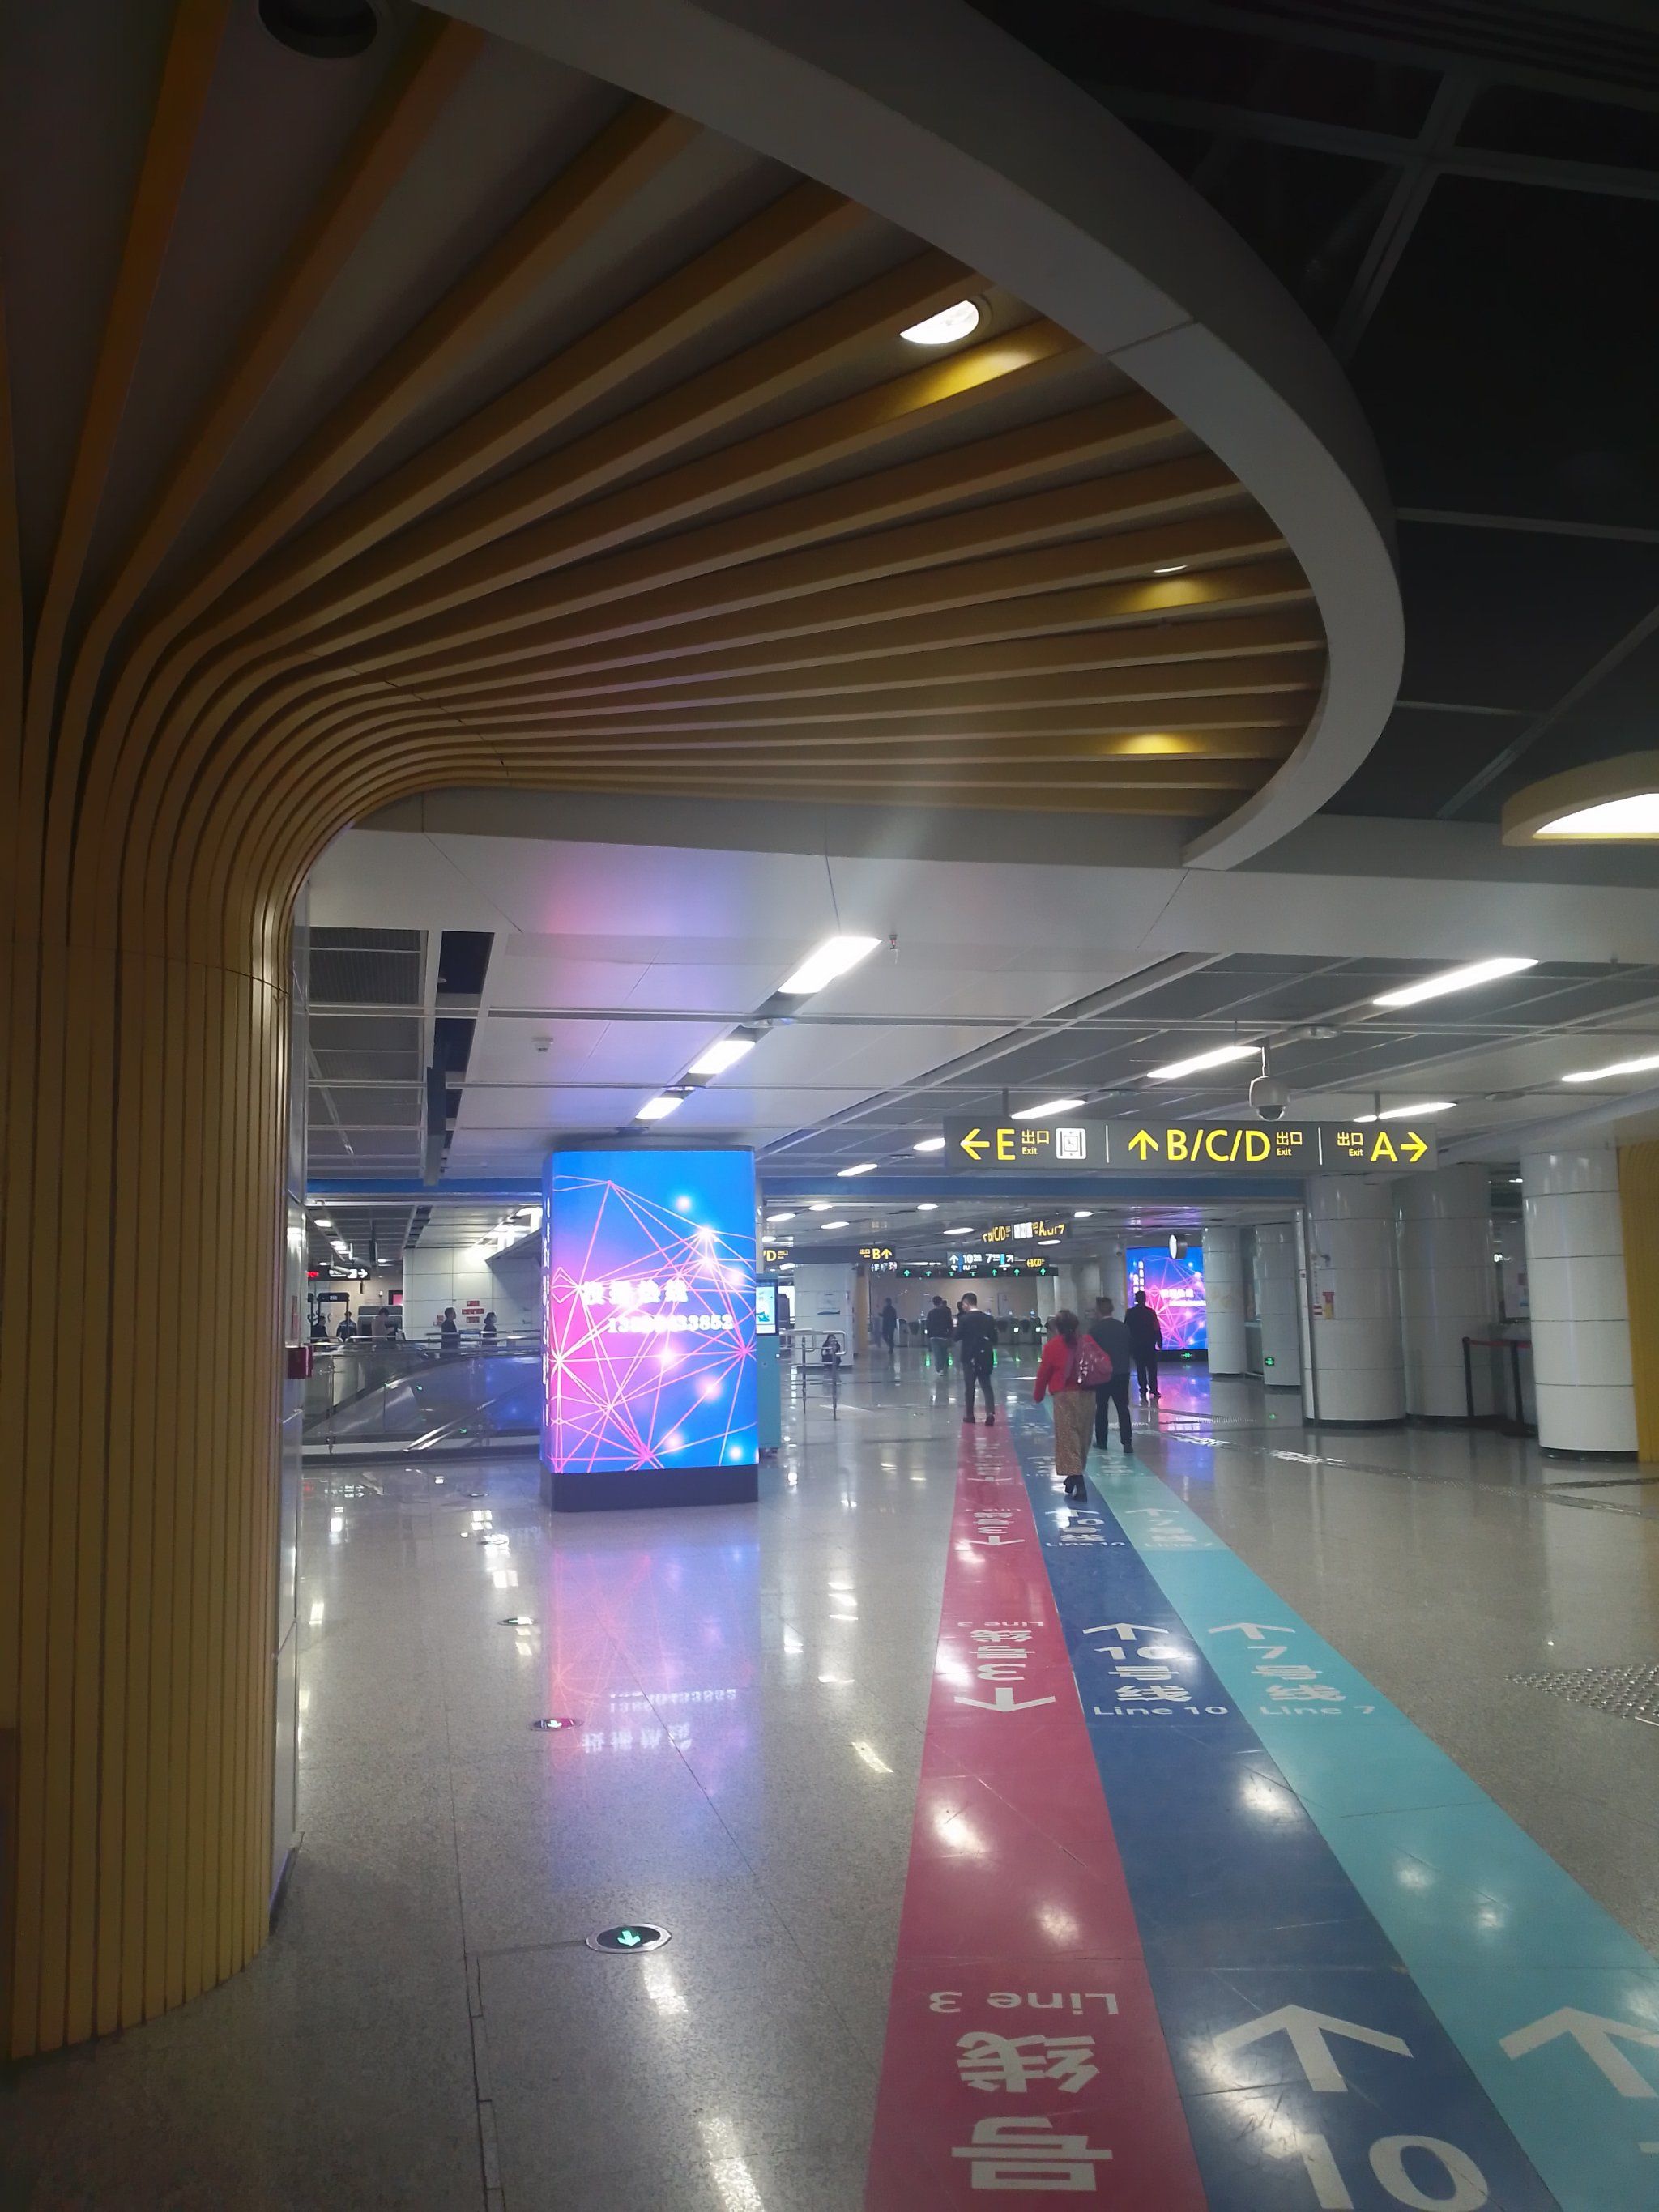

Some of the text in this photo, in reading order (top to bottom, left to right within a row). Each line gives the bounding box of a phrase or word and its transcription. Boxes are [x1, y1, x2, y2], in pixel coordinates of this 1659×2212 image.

[1022, 1129, 1050, 1144] 出口
[1277, 1131, 1303, 1145] 出口
[1337, 1132, 1363, 1146] 出口
[997, 1129, 1015, 1160] E
[1021, 1147, 1038, 1155] Exit
[1167, 1129, 1271, 1161] B/C/D
[1370, 1132, 1398, 1162] A
[1349, 1149, 1363, 1157] Exit
[872, 1248, 881, 1260] B
[1093, 1706, 1230, 1715] Line 10
[1259, 1706, 1376, 1715] Line 7
[929, 1991, 1120, 2015] Line 3
[1264, 2133, 1489, 2212] 10
